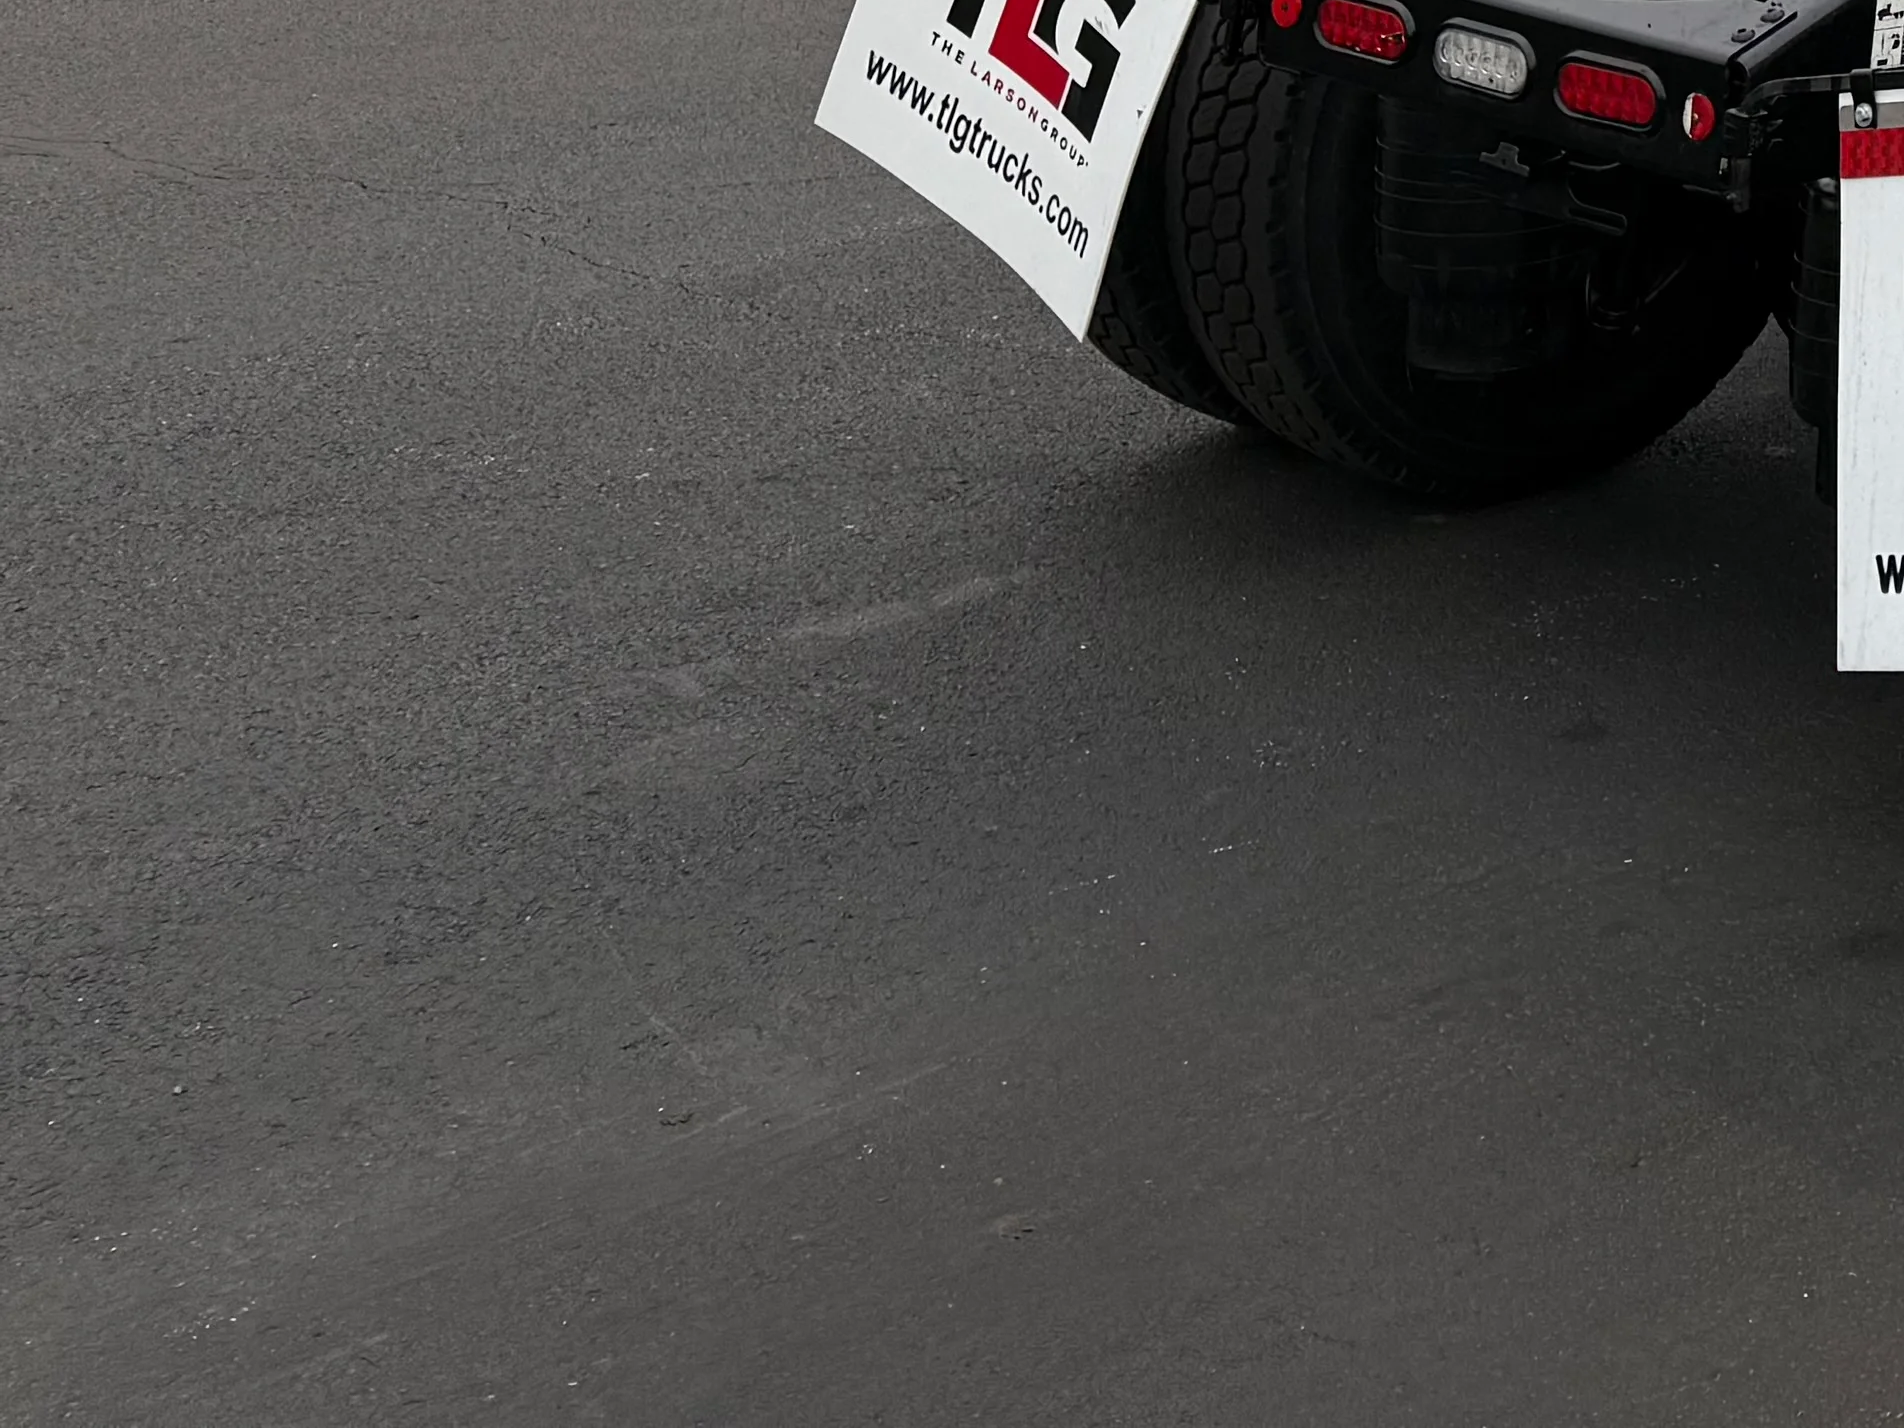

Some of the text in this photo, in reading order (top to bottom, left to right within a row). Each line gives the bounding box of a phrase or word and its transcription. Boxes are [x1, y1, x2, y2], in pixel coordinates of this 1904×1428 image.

[866, 48, 1091, 260] www.tlgtrucks.com
[930, 29, 1088, 169] THE LARSON GROUP
